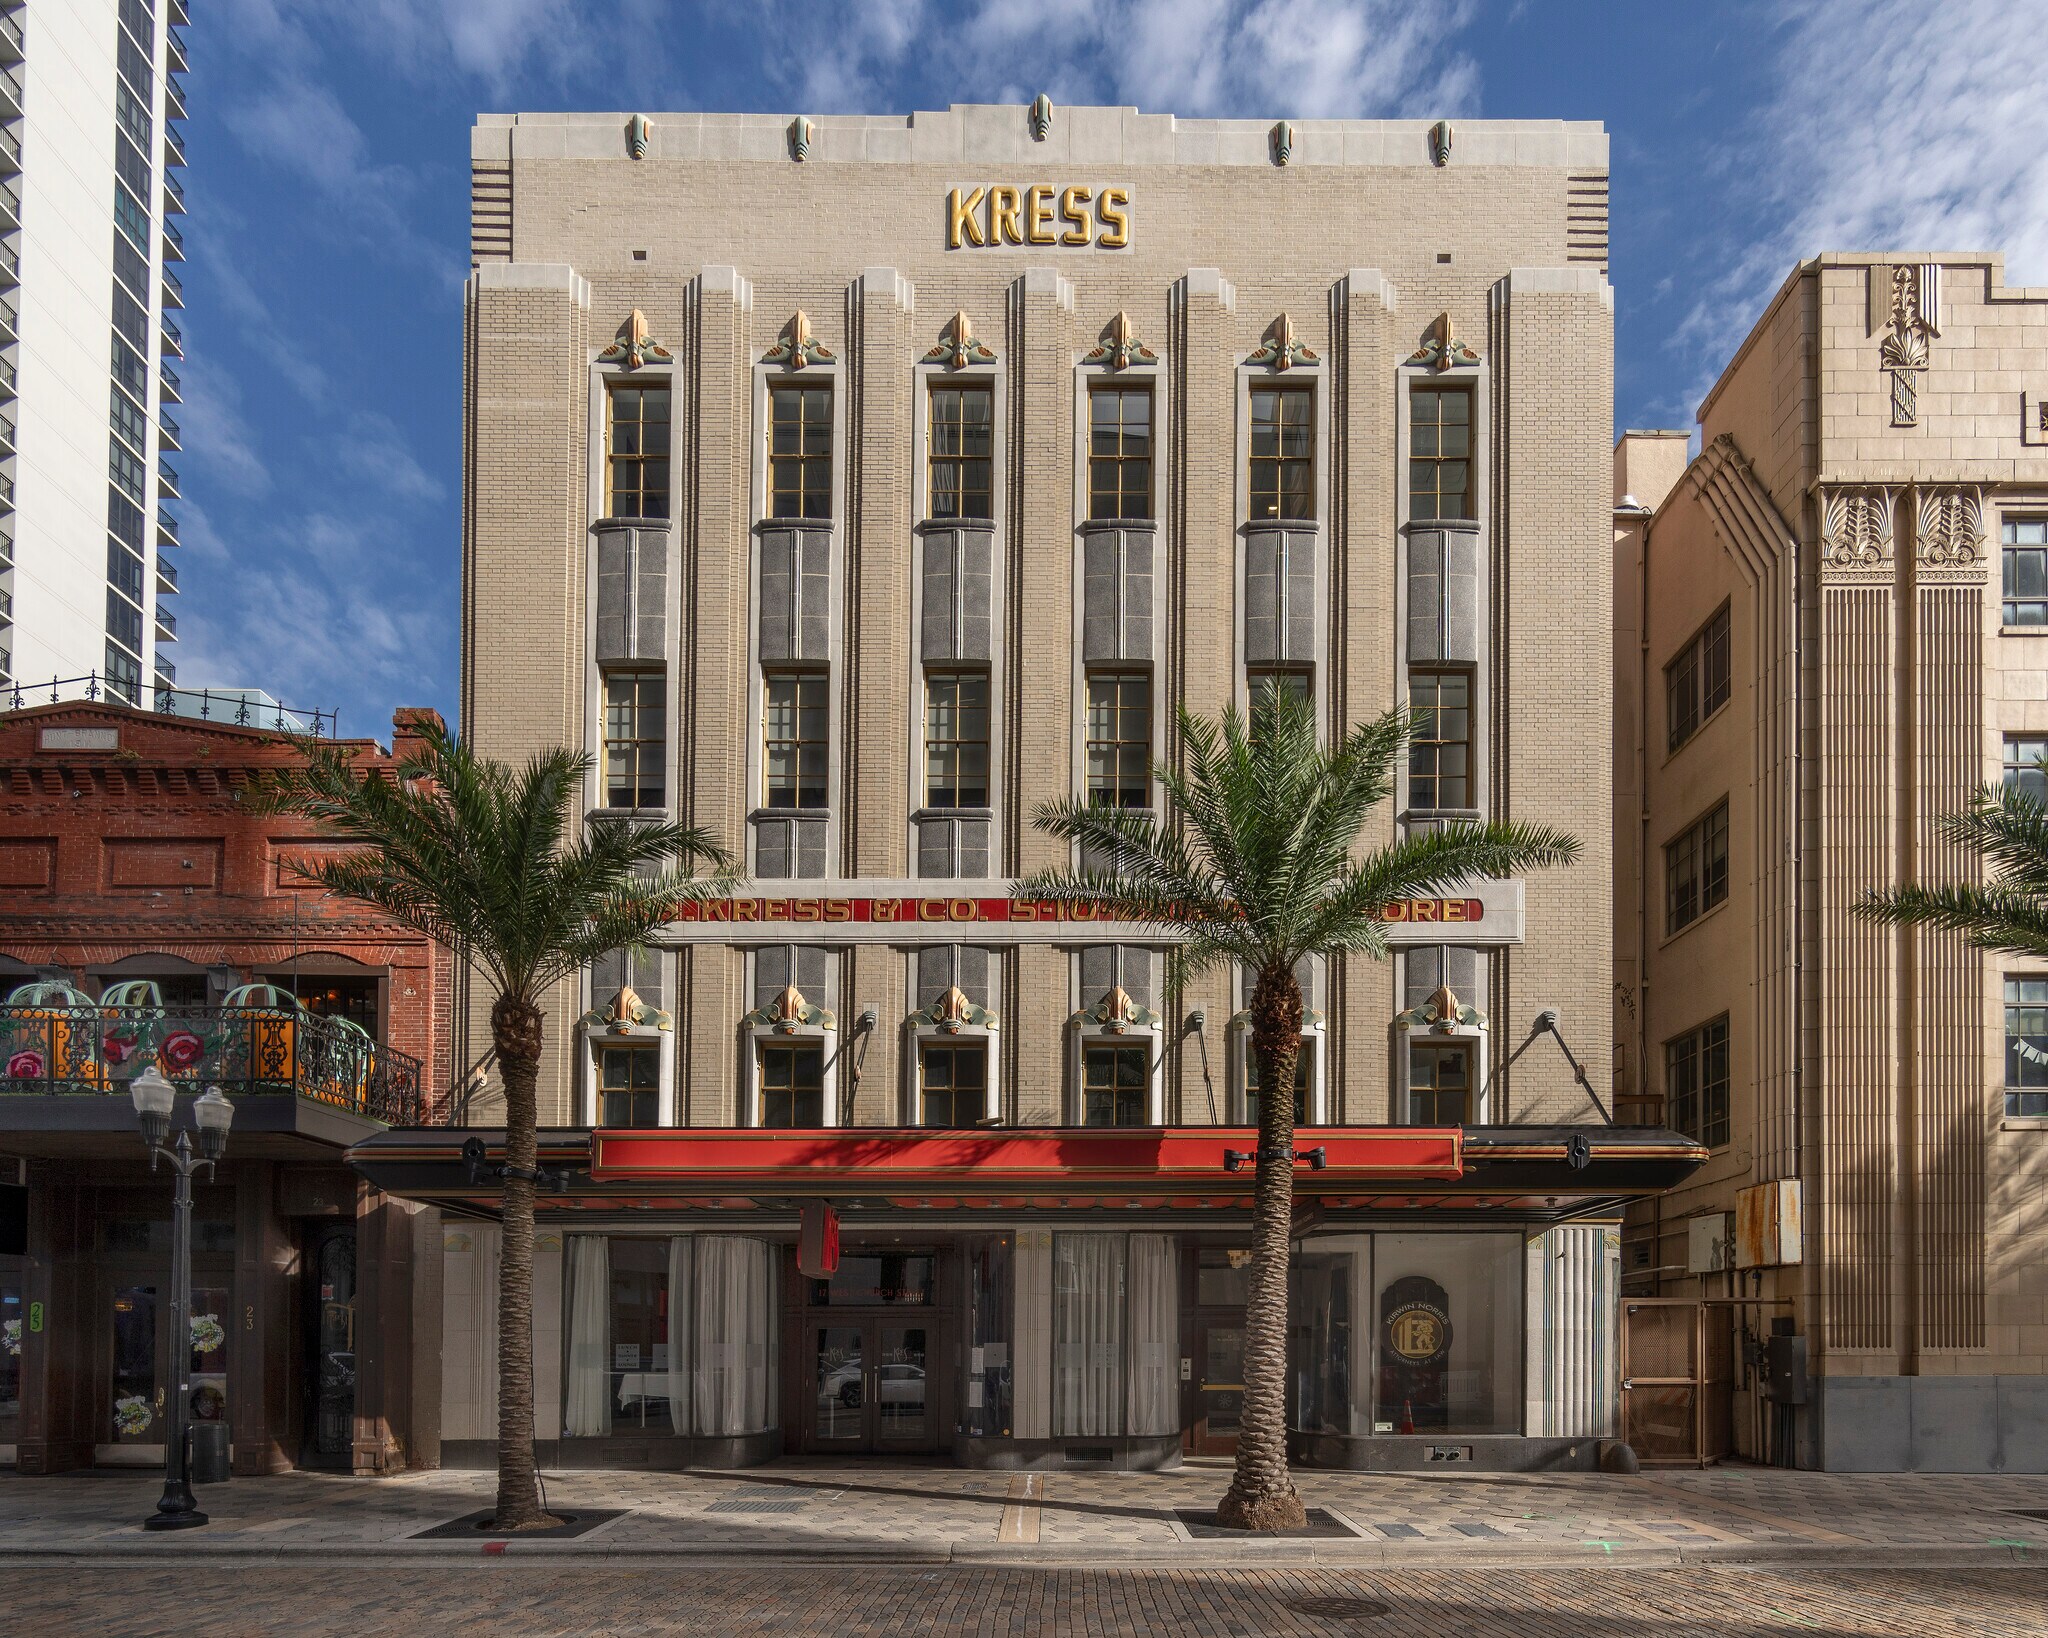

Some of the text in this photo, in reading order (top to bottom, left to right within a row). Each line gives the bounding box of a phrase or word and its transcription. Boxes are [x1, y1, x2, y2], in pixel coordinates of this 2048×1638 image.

[950, 185, 1129, 248] KRESS
[873, 898, 901, 922] &
[919, 898, 988, 922] CO.
[31, 1303, 41, 1330] 25
[246, 1305, 254, 1330] 23
[1386, 1303, 1449, 1325] KIRWIN NORRIS
[1390, 1350, 1420, 1366] ATTORNEYS
[1434, 1350, 1445, 1360] LAW
